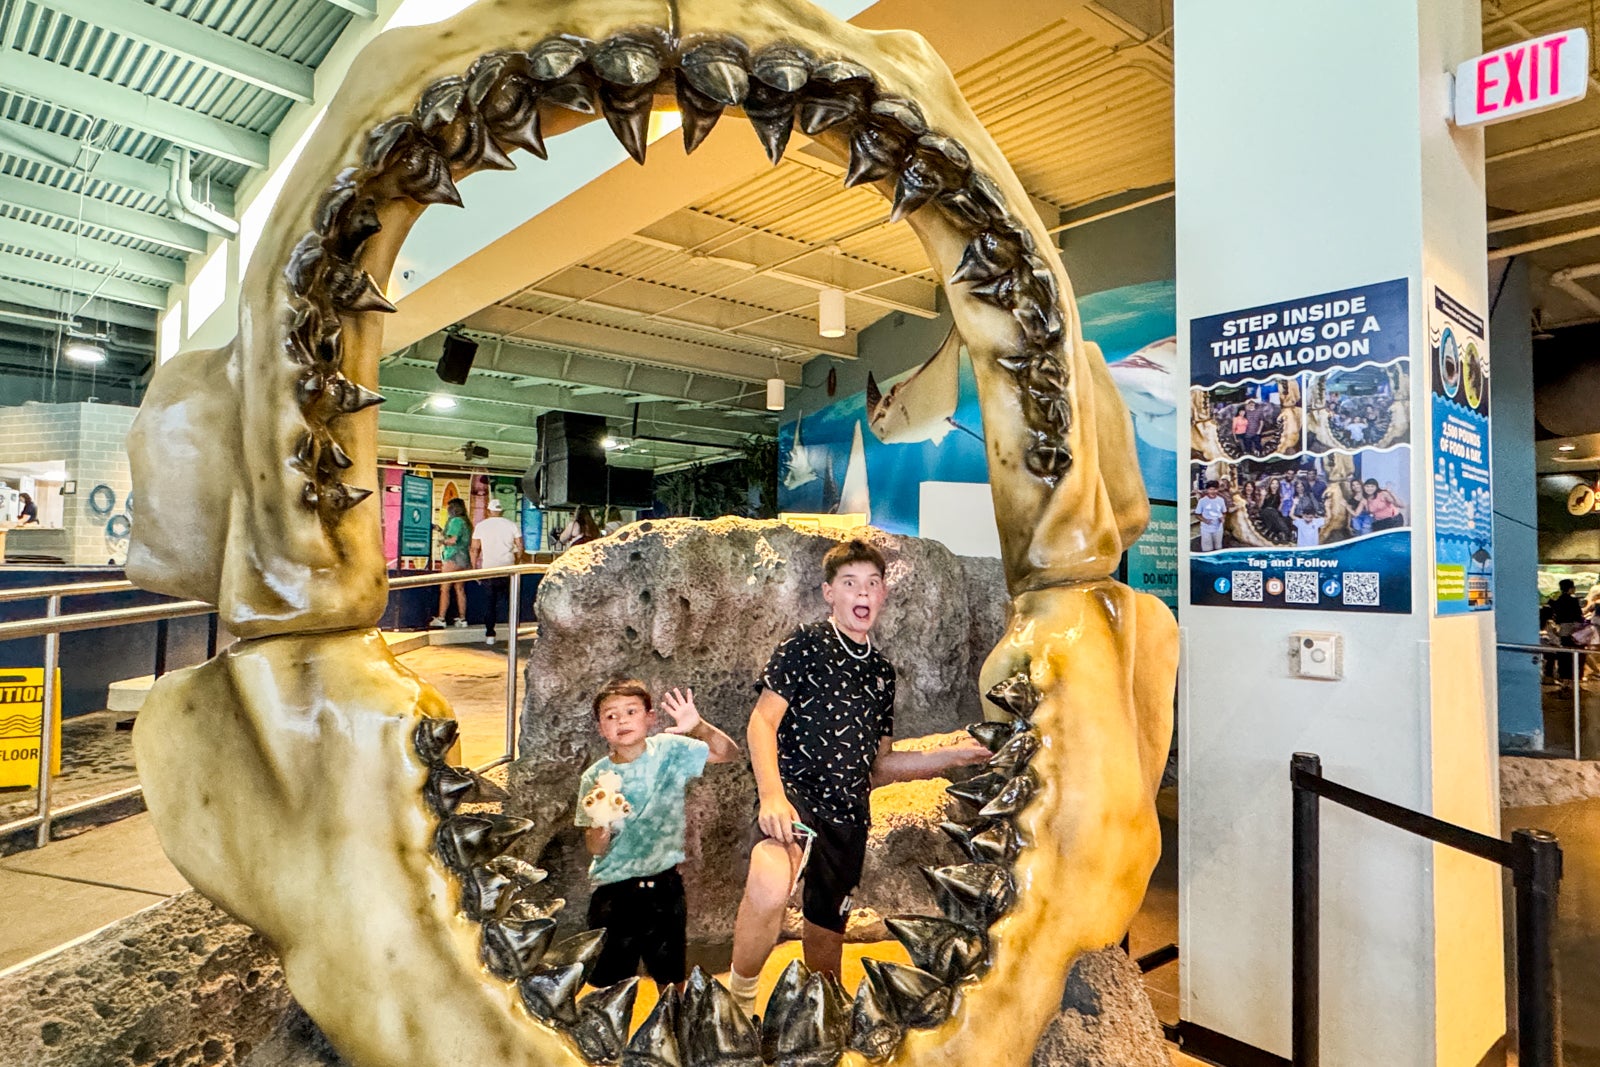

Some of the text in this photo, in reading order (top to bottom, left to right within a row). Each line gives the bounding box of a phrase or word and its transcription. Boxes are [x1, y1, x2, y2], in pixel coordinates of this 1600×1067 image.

[1476, 35, 1568, 115] EXIT
[1222, 296, 1367, 337] STEP INSIDE
[1210, 315, 1381, 357] THE JAWS OF A
[1219, 338, 1370, 376] MEGALODON
[1159, 546, 1178, 556] TOUC
[1247, 557, 1338, 569] Tag and Follow
[1143, 573, 1156, 584] DO
[1157, 573, 1173, 584] NOT
